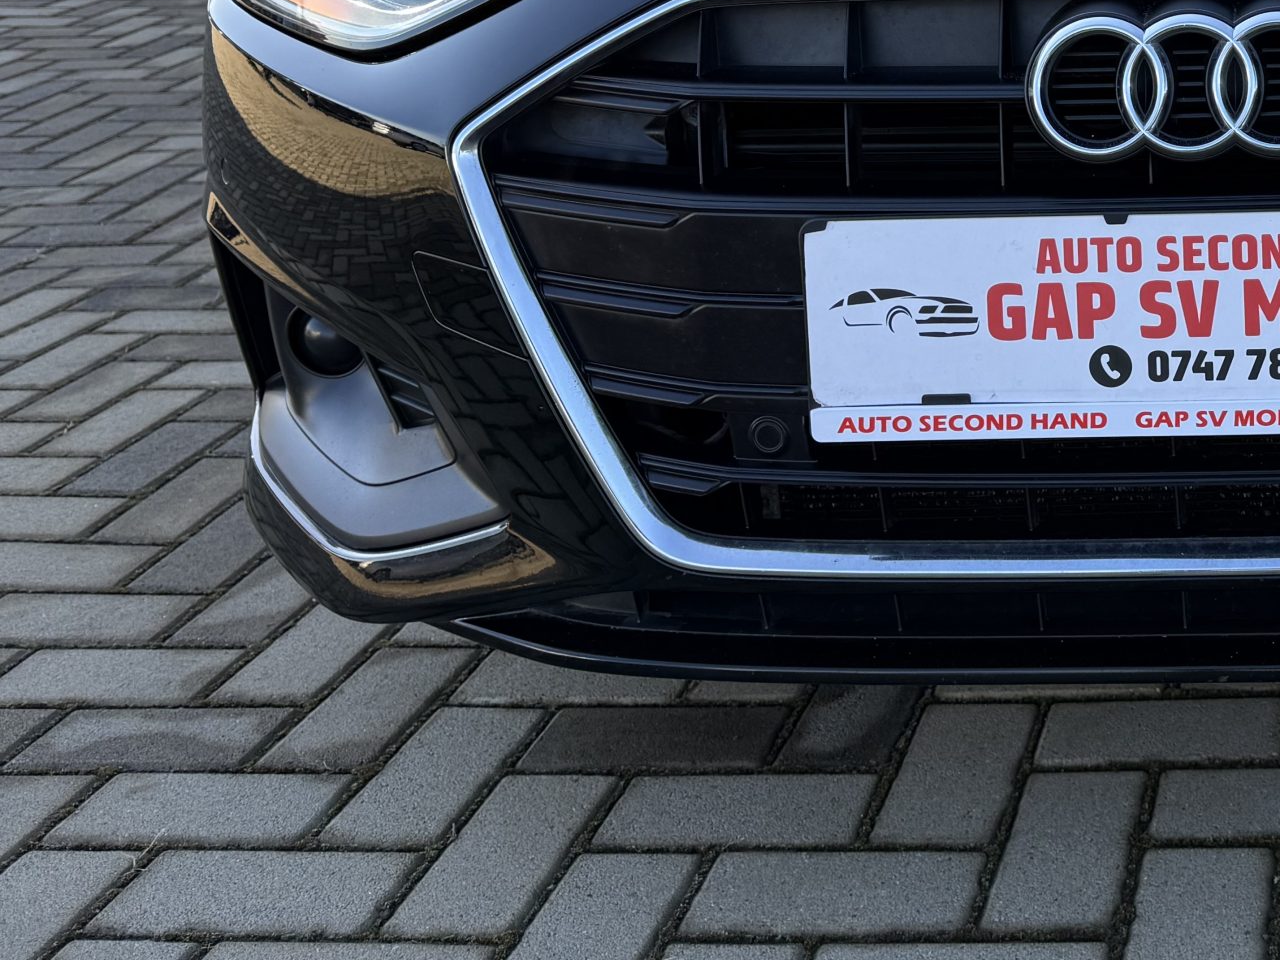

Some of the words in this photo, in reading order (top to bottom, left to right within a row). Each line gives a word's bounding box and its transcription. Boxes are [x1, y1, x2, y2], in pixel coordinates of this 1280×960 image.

[1036, 237, 1143, 274] AUTO
[986, 282, 1116, 341] GAP
[1140, 280, 1220, 339] SV
[1146, 349, 1236, 383] 0747
[837, 415, 913, 434] AUTO
[918, 414, 1024, 433] SECOND
[1030, 413, 1108, 430] HAND
[1134, 411, 1190, 429] GAP
[1195, 411, 1228, 428] SV
